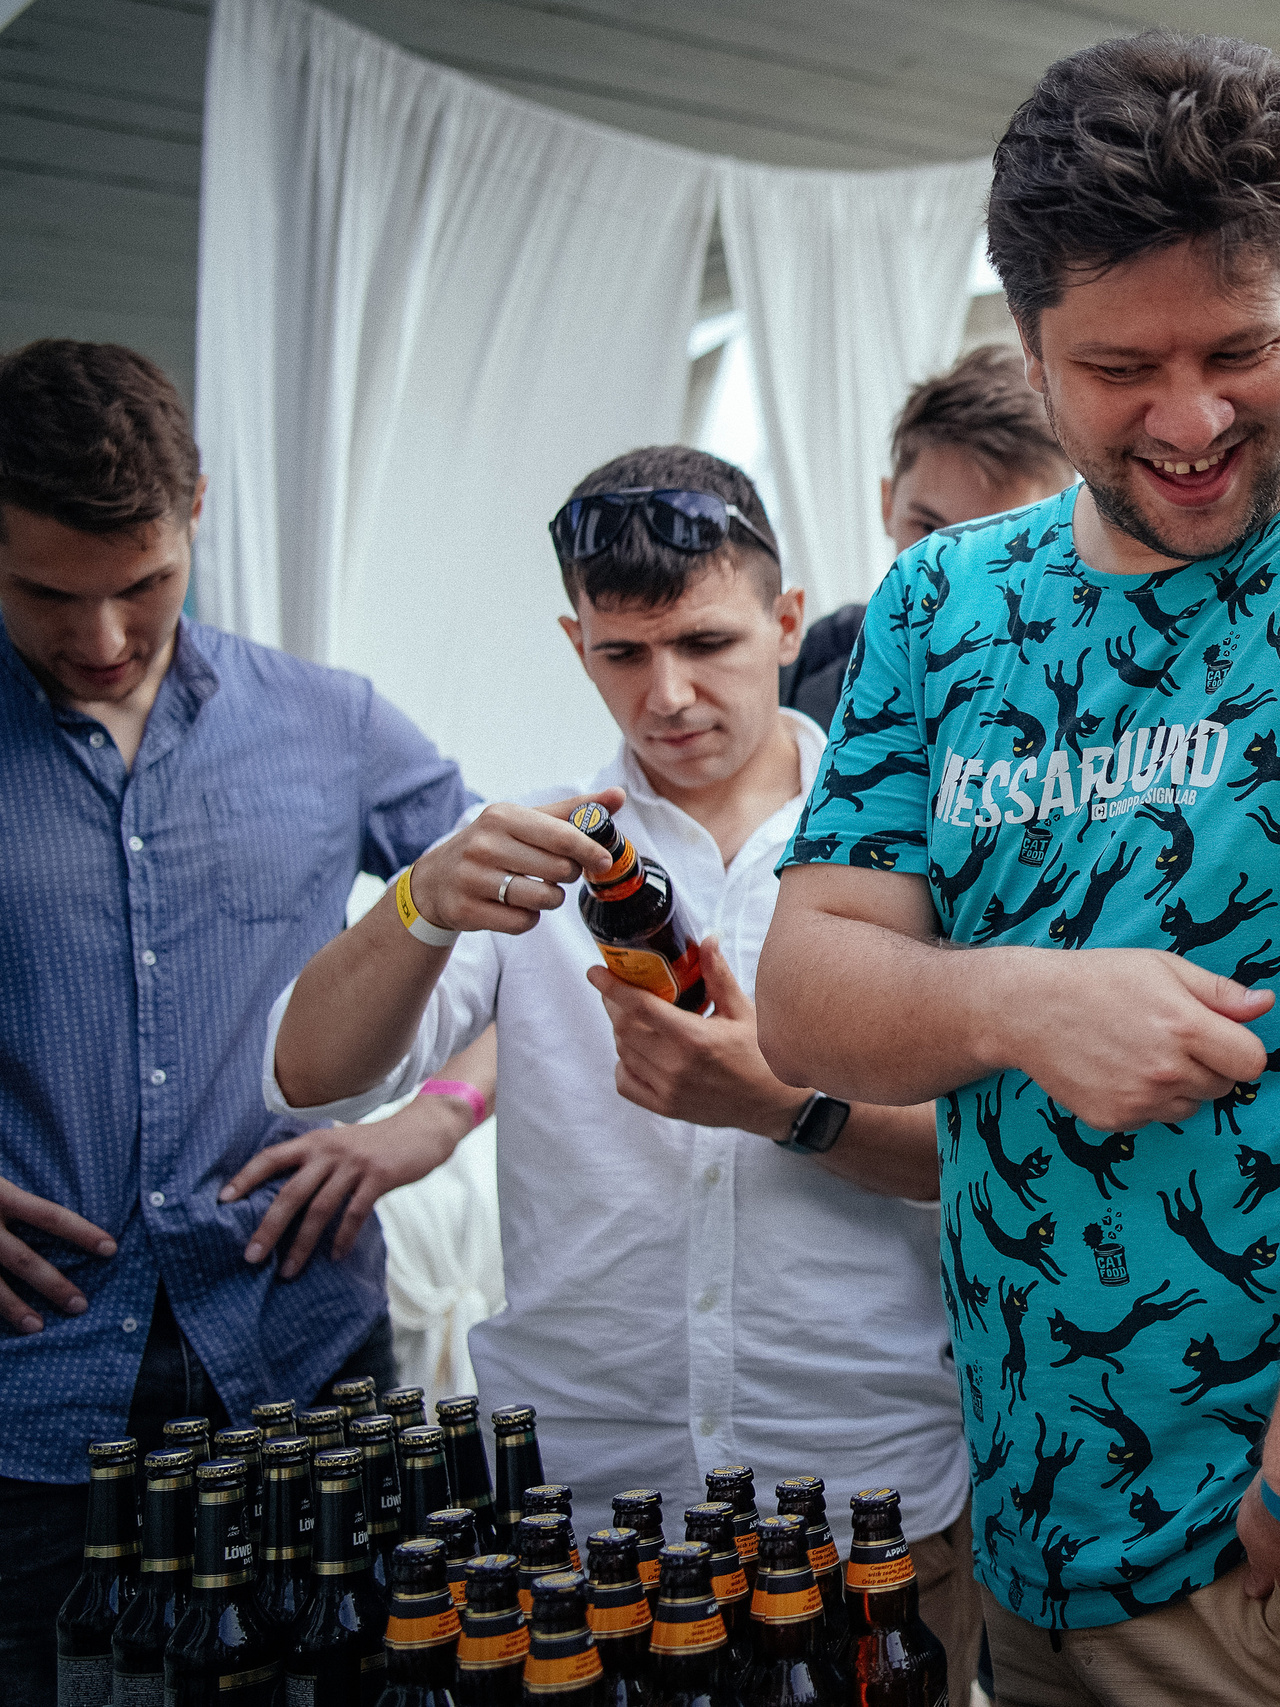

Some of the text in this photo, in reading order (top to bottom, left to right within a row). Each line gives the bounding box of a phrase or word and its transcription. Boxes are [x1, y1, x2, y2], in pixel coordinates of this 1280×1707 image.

[1207, 667, 1230, 681] CAT
[1109, 795, 1140, 818] CROPP
[1174, 788, 1198, 806] LAB
[1022, 837, 1049, 851] CAT
[1021, 848, 1045, 861] FOOD
[1096, 1252, 1123, 1269] CAT
[1099, 1266, 1127, 1278] FOOD
